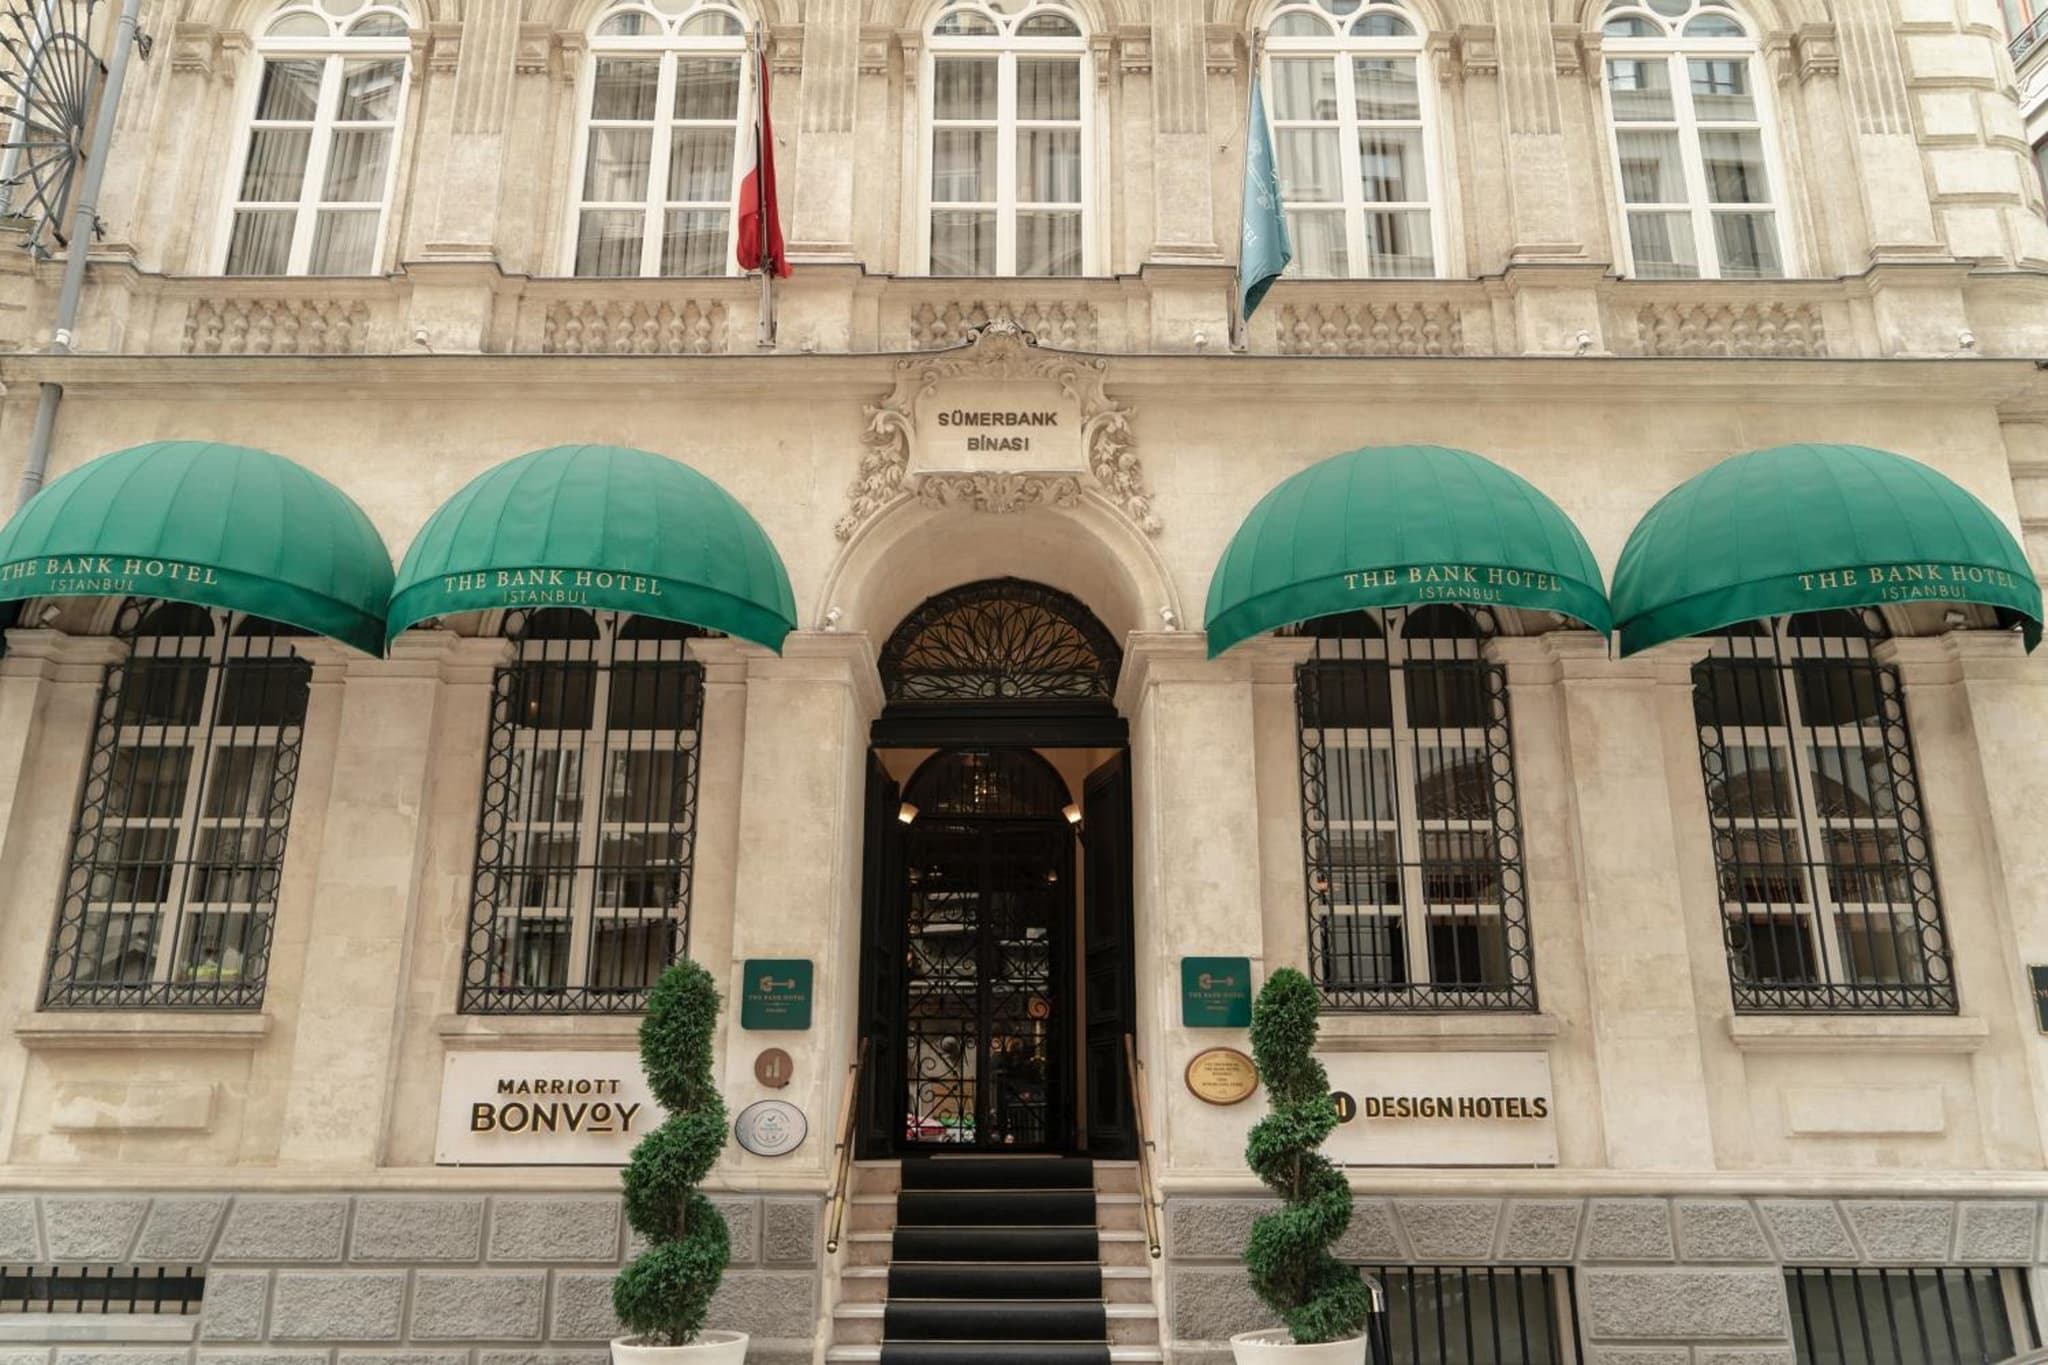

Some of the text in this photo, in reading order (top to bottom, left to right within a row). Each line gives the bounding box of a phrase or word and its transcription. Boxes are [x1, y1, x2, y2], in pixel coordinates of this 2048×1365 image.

[938, 409, 1058, 426] SÜMERBANK
[967, 434, 1029, 451] BİNASI
[1, 557, 218, 585] THE BANK HOTEL
[1344, 565, 1561, 592] THE BANK HOTEL
[1799, 564, 2017, 591] THE BANK HOTEL
[51, 578, 134, 592] ISTANBUL
[445, 569, 662, 596] THE BANK HOTEL
[503, 590, 587, 605] ISTANBUL
[1419, 586, 1503, 602] ISTANBUL
[497, 1079, 621, 1094] MARRIOTT
[471, 1102, 641, 1132] BONVOY
[1365, 1096, 1548, 1119] DESIGN HOTELS
